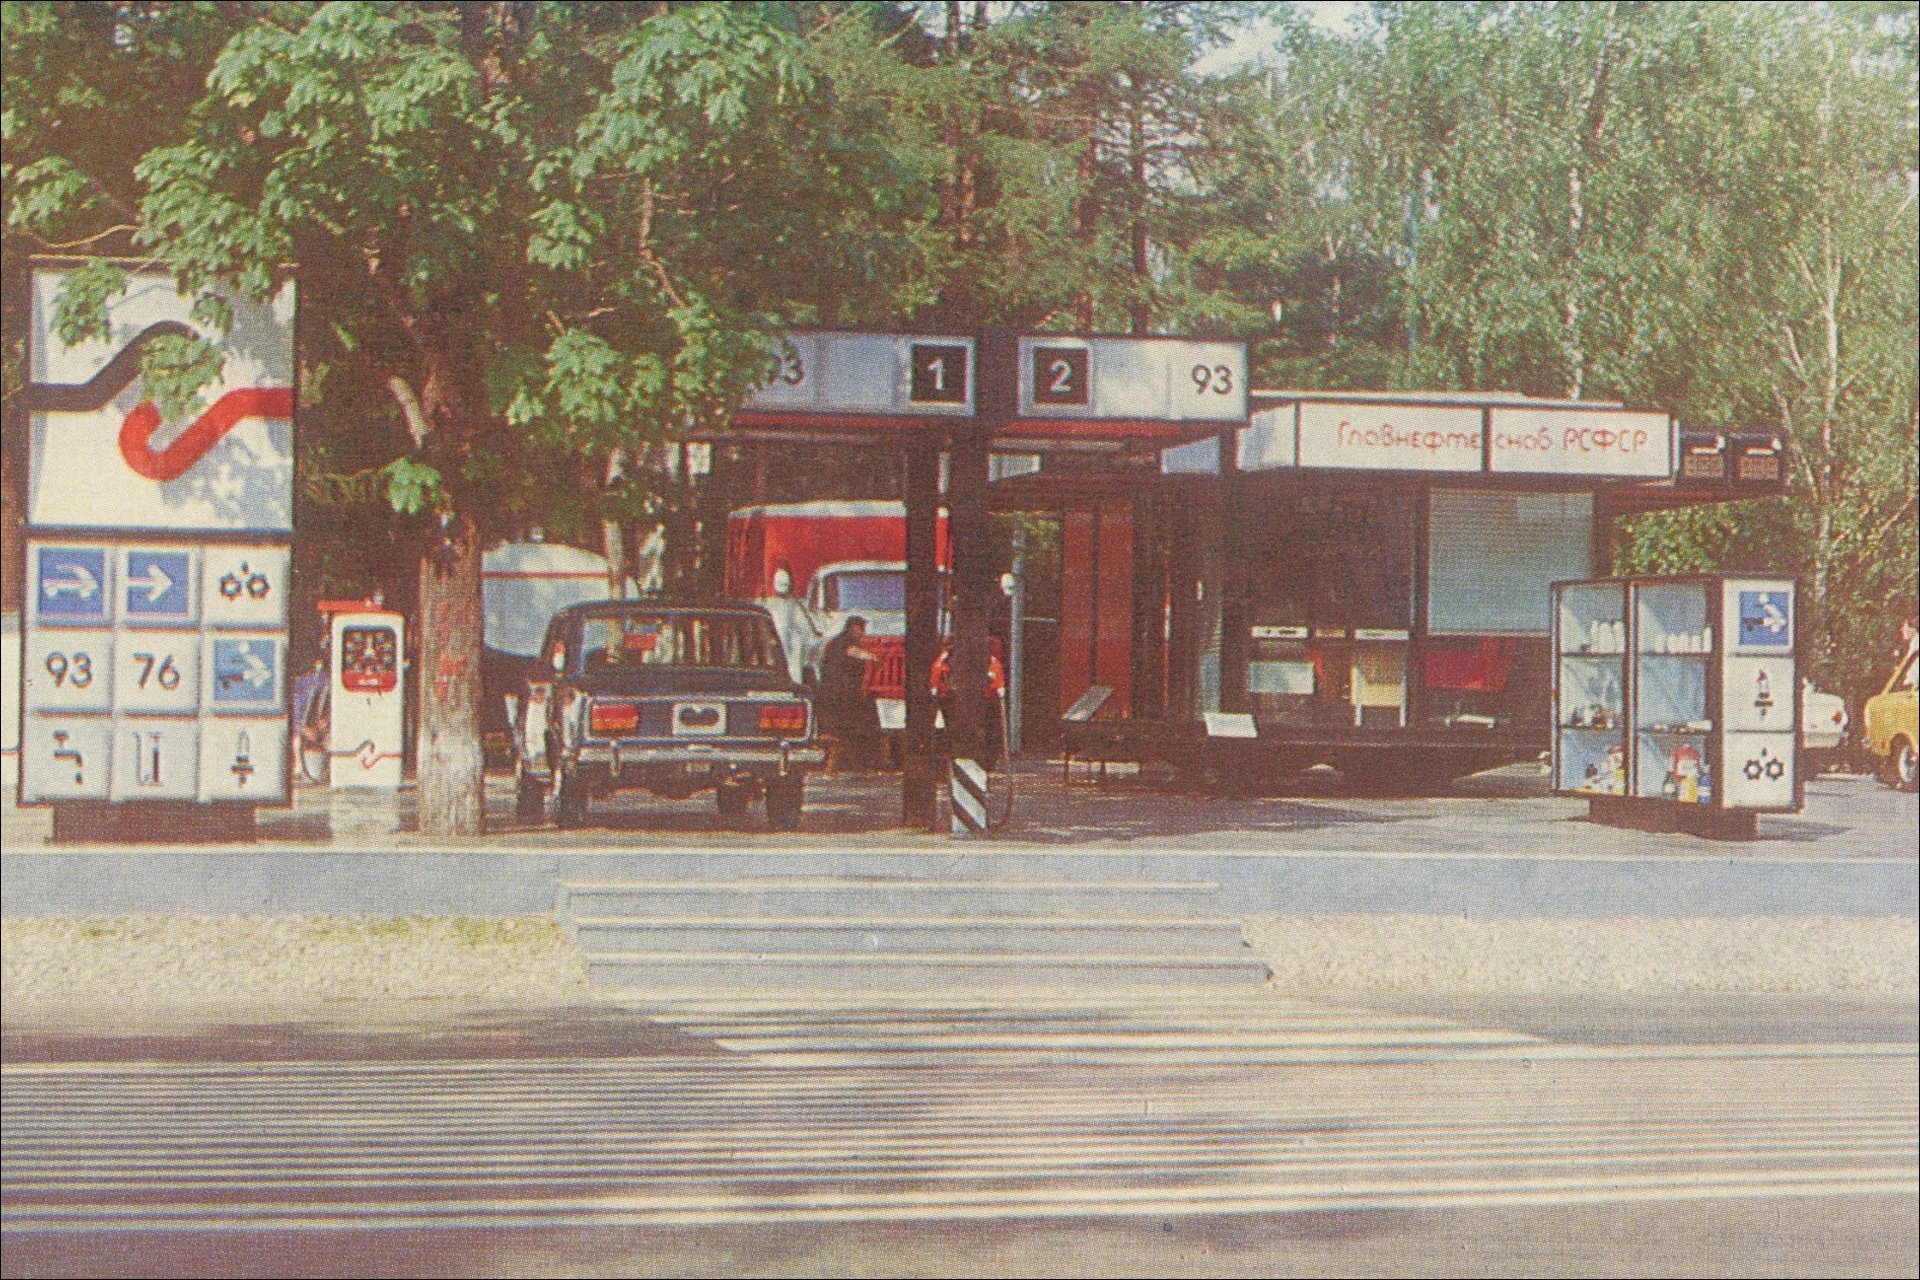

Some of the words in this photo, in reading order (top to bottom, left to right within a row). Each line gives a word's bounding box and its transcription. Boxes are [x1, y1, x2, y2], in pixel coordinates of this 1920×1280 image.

[766, 355, 805, 386] 3
[927, 357, 944, 391] 1
[1050, 359, 1073, 393] 2
[1191, 363, 1233, 395] 93
[1563, 427, 1648, 453] РСФСР
[46, 651, 93, 689] 93
[133, 652, 181, 691] 76
